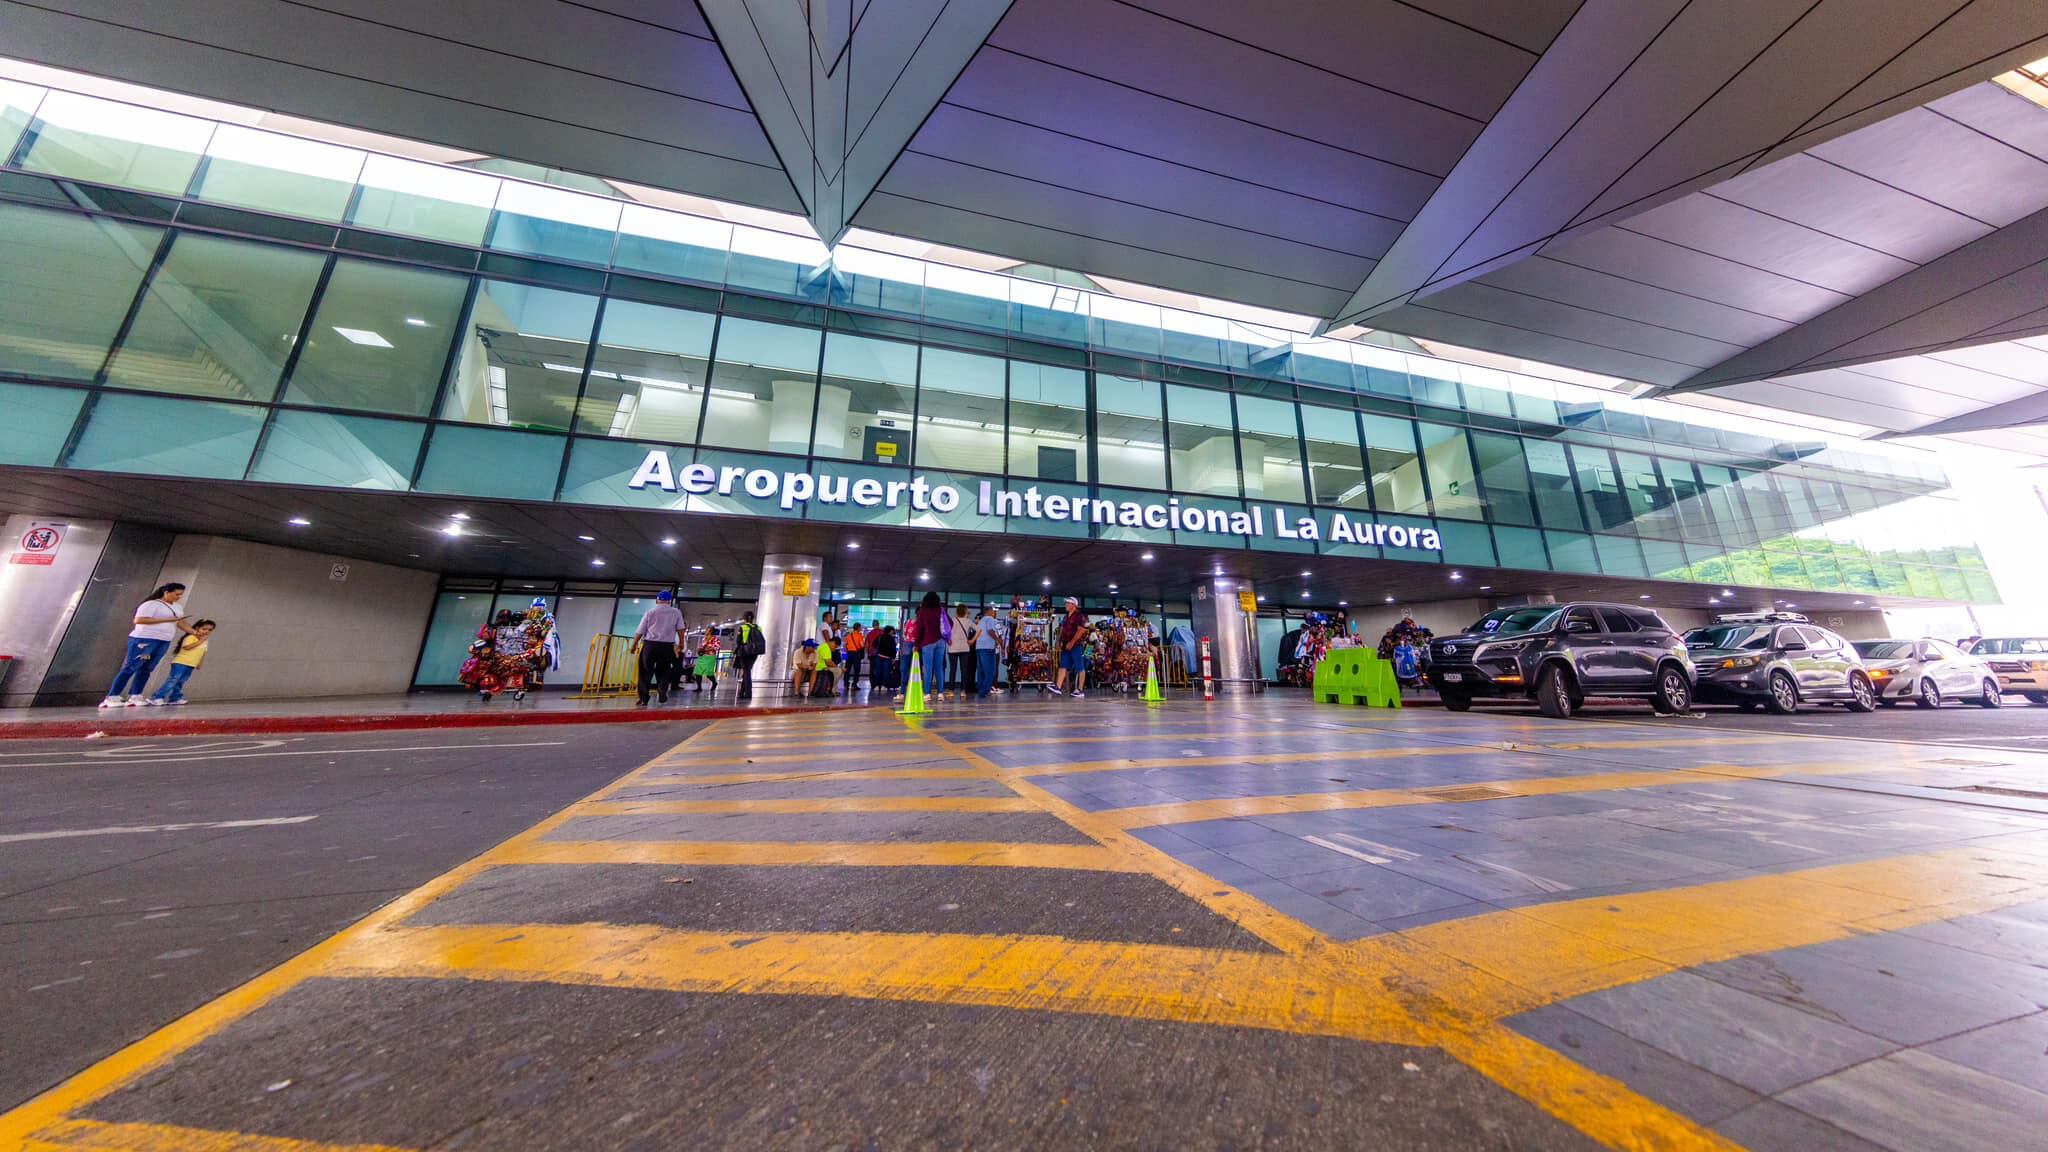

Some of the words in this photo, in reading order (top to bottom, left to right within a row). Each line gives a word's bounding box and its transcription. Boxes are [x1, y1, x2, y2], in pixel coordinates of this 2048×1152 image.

[628, 450, 960, 513] Aeropuerto
[978, 480, 1263, 537] Internacional
[1273, 508, 1320, 540] La
[1328, 513, 1442, 551] Aurora
